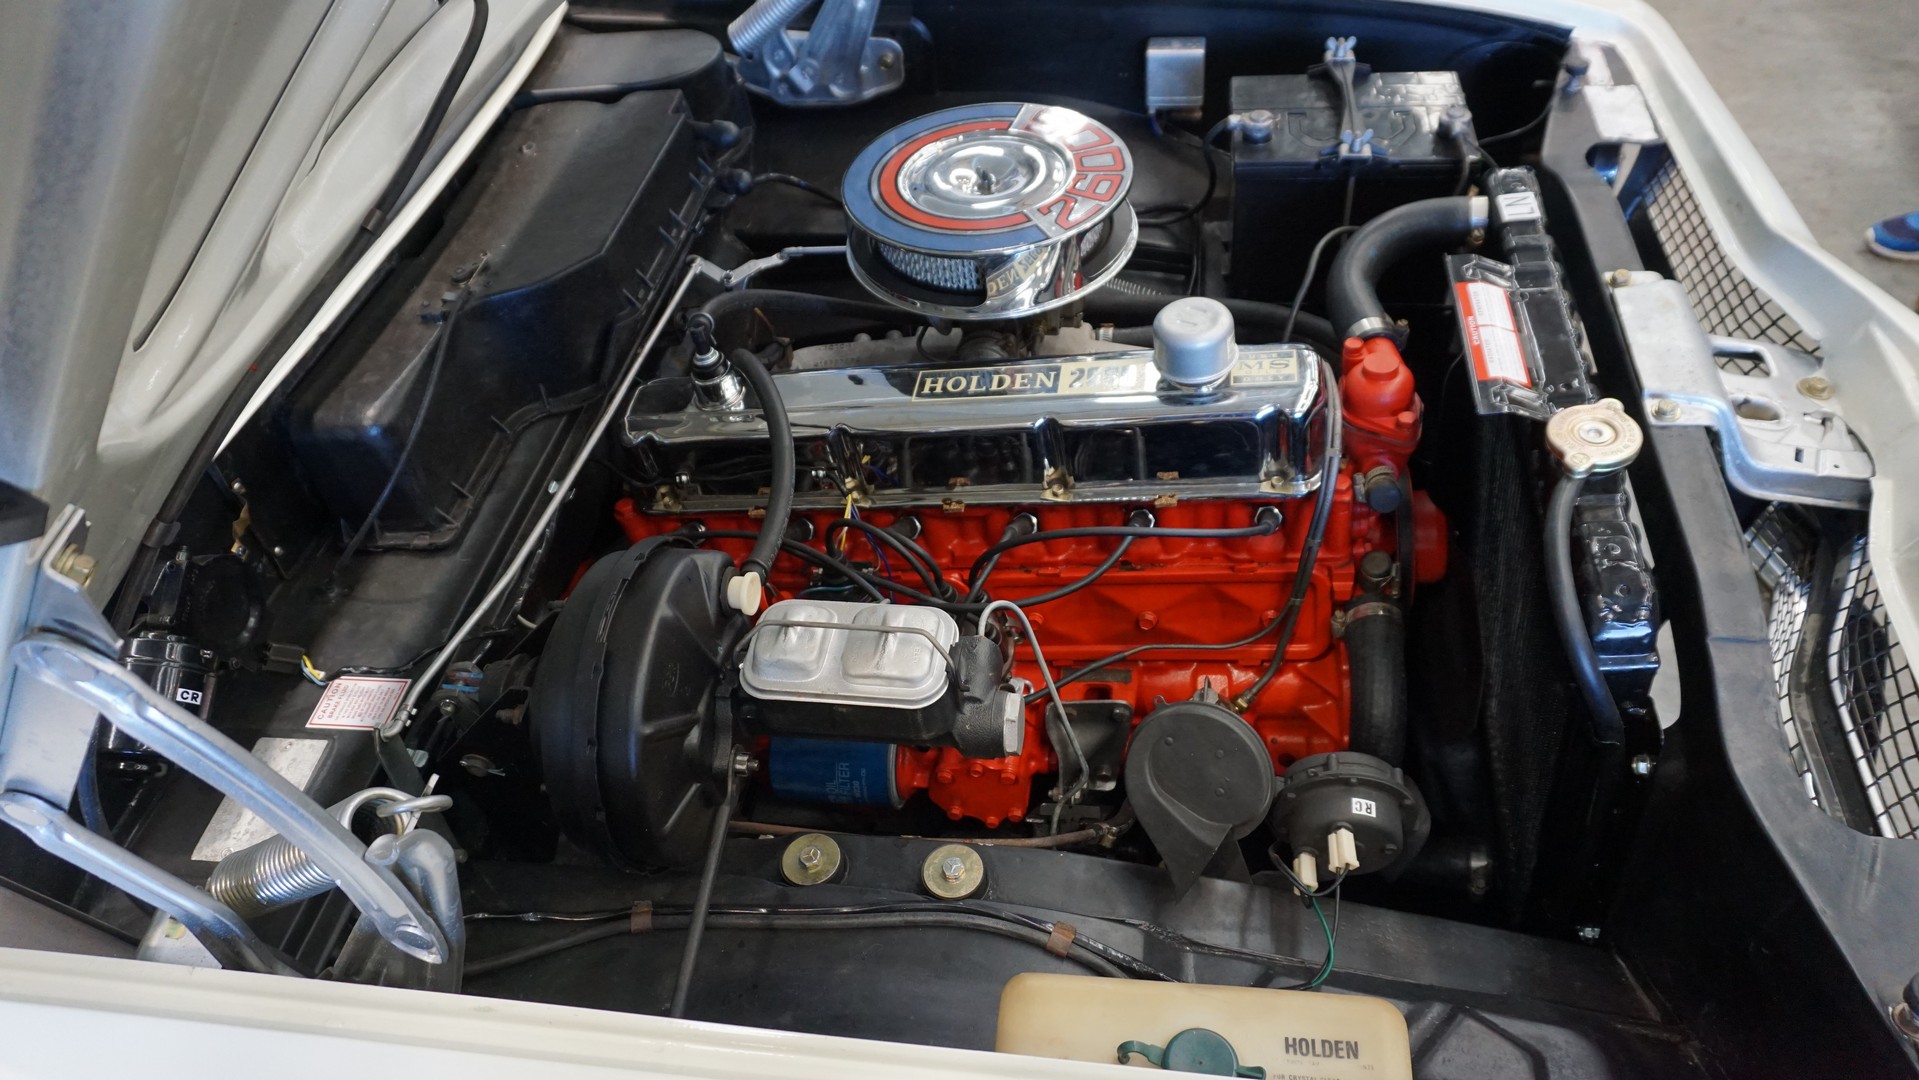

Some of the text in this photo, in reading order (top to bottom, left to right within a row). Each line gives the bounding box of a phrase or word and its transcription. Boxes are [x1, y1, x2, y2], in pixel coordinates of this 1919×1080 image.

[1469, 315, 1480, 345] CAUTION
[1238, 359, 1290, 370] MS
[921, 371, 1057, 394] HOLDEN
[180, 690, 200, 703] CR
[318, 682, 342, 719] CAUTION
[1354, 800, 1373, 815] RC
[1284, 1036, 1360, 1060] HOLDEN
